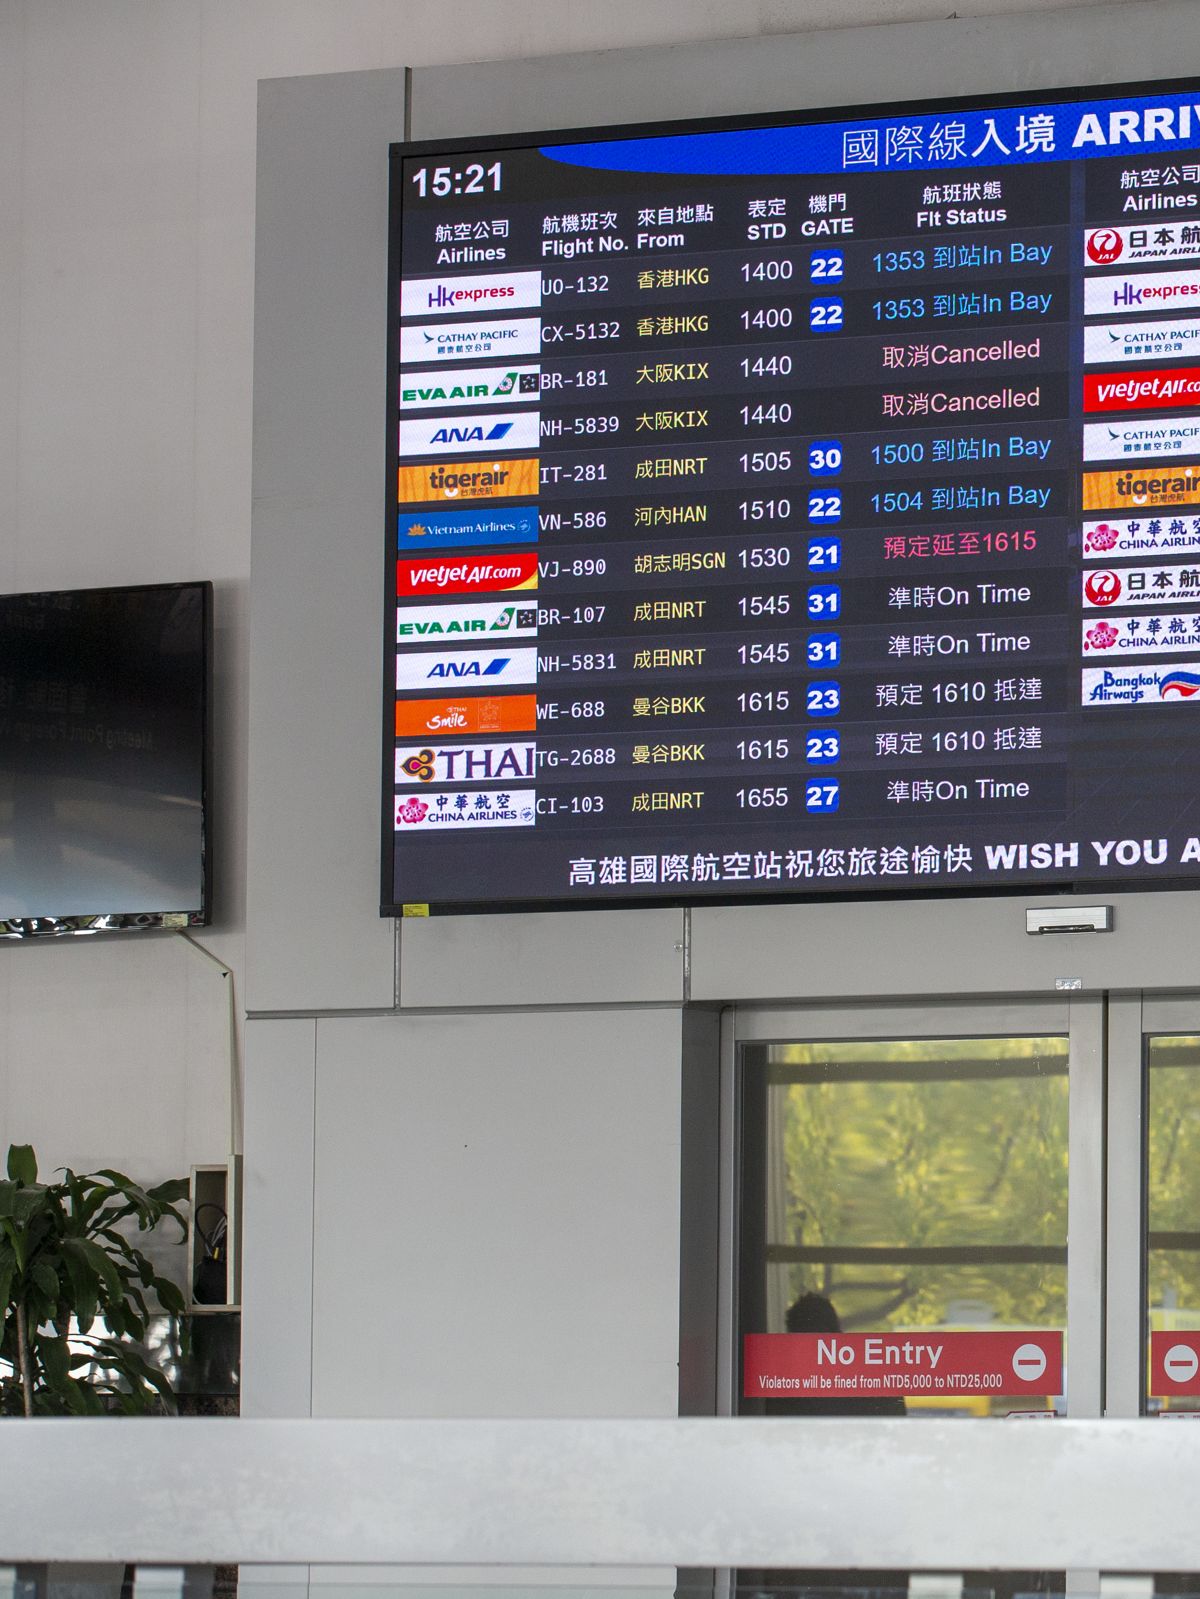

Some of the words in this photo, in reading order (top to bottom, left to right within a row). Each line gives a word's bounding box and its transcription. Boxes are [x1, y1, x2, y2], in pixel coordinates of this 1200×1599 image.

[843, 113, 1055, 168] 國際線入境
[413, 163, 501, 197] 15:21
[1121, 165, 1200, 189] 航空公司
[809, 193, 846, 213] 機門
[923, 181, 1001, 204] 航班狀態
[1123, 194, 1197, 211] Airlines
[638, 204, 714, 226] 來自地點
[749, 198, 786, 218] 表定
[917, 211, 941, 227] Flt
[946, 208, 1007, 224] Status
[435, 220, 508, 242] 航空公司
[543, 212, 617, 237] 航機班次
[748, 223, 786, 240] STD
[802, 218, 853, 236] GATE
[543, 238, 593, 258] Flight
[599, 236, 628, 251] No.
[638, 233, 684, 248] From
[437, 247, 505, 264] Airlines
[873, 251, 925, 272] 1353
[933, 244, 1001, 268] 到站In
[1011, 243, 1052, 265] Bay
[637, 267, 709, 290] 香港HKG
[740, 259, 793, 283] 1400
[810, 257, 843, 278] 22
[542, 274, 609, 296] UO-132
[636, 315, 709, 337] 香港HKG
[740, 307, 793, 330] 1400
[810, 305, 843, 326] 22
[541, 321, 620, 343] CX-5132
[882, 337, 1041, 369] 取消Cancelled
[635, 362, 709, 385] 大阪KIX
[740, 355, 793, 378] 1440
[541, 369, 609, 390] BR-181
[635, 409, 709, 432] 大阪KIX
[739, 403, 792, 426] 1440
[430, 427, 483, 443] ANA
[540, 415, 620, 437] NH-5839
[634, 457, 709, 479] 成田NRT
[739, 450, 792, 473] 1505
[809, 448, 841, 469] 30
[429, 464, 509, 491] tigerair
[540, 463, 608, 485] IT-281
[634, 505, 707, 527] 河內HAN
[738, 498, 791, 521] 1510
[808, 497, 841, 517] 22
[539, 510, 607, 531] VN-586
[808, 545, 838, 566] 21
[883, 529, 1037, 560] 預定延至1615
[539, 558, 607, 579] VJ-890
[634, 551, 726, 574] 胡志明SGN
[738, 546, 791, 569] 1530
[738, 594, 791, 617] 1545
[808, 593, 837, 613] 31
[887, 584, 970, 610] 準時On
[976, 583, 1032, 604] Time
[538, 605, 606, 626] BR-107
[633, 600, 707, 622] 成田NRT
[632, 648, 707, 669] 成田NRT
[737, 642, 790, 665] 1545
[808, 641, 837, 661] 31
[538, 652, 617, 673] NH-5831
[1104, 671, 1162, 688] Bangkok
[537, 700, 605, 720] WE-688
[632, 696, 706, 717] 曼谷BKK
[737, 690, 790, 713] 1615
[807, 689, 840, 710] 23
[537, 747, 616, 768] TG-2688
[631, 743, 706, 765] 曼谷BKK
[736, 738, 790, 761] 1615
[806, 737, 839, 758] 23
[436, 746, 535, 781] THAI
[435, 793, 510, 812] 中華航空
[536, 795, 604, 815] CI-103
[631, 791, 705, 812] 成田NRT
[735, 786, 789, 809] 1655
[806, 785, 839, 806] 27
[428, 813, 464, 822] CHINA
[467, 810, 517, 820] AIRLINES
[569, 844, 972, 885] 高雄國際航空站祝您旅途愉快
[985, 843, 1078, 869] WISH
[1091, 839, 1167, 865] YOU
[818, 1339, 854, 1364] No
[865, 1339, 943, 1368] Entry
[759, 1376, 800, 1388] Violators
[802, 1374, 821, 1389] will
[823, 1374, 833, 1389] be
[834, 1375, 857, 1388] fined
[860, 1375, 880, 1388] from
[884, 1375, 931, 1389] NTD5,000
[935, 1376, 944, 1387] to
[947, 1374, 1002, 1389] NTD25,000
